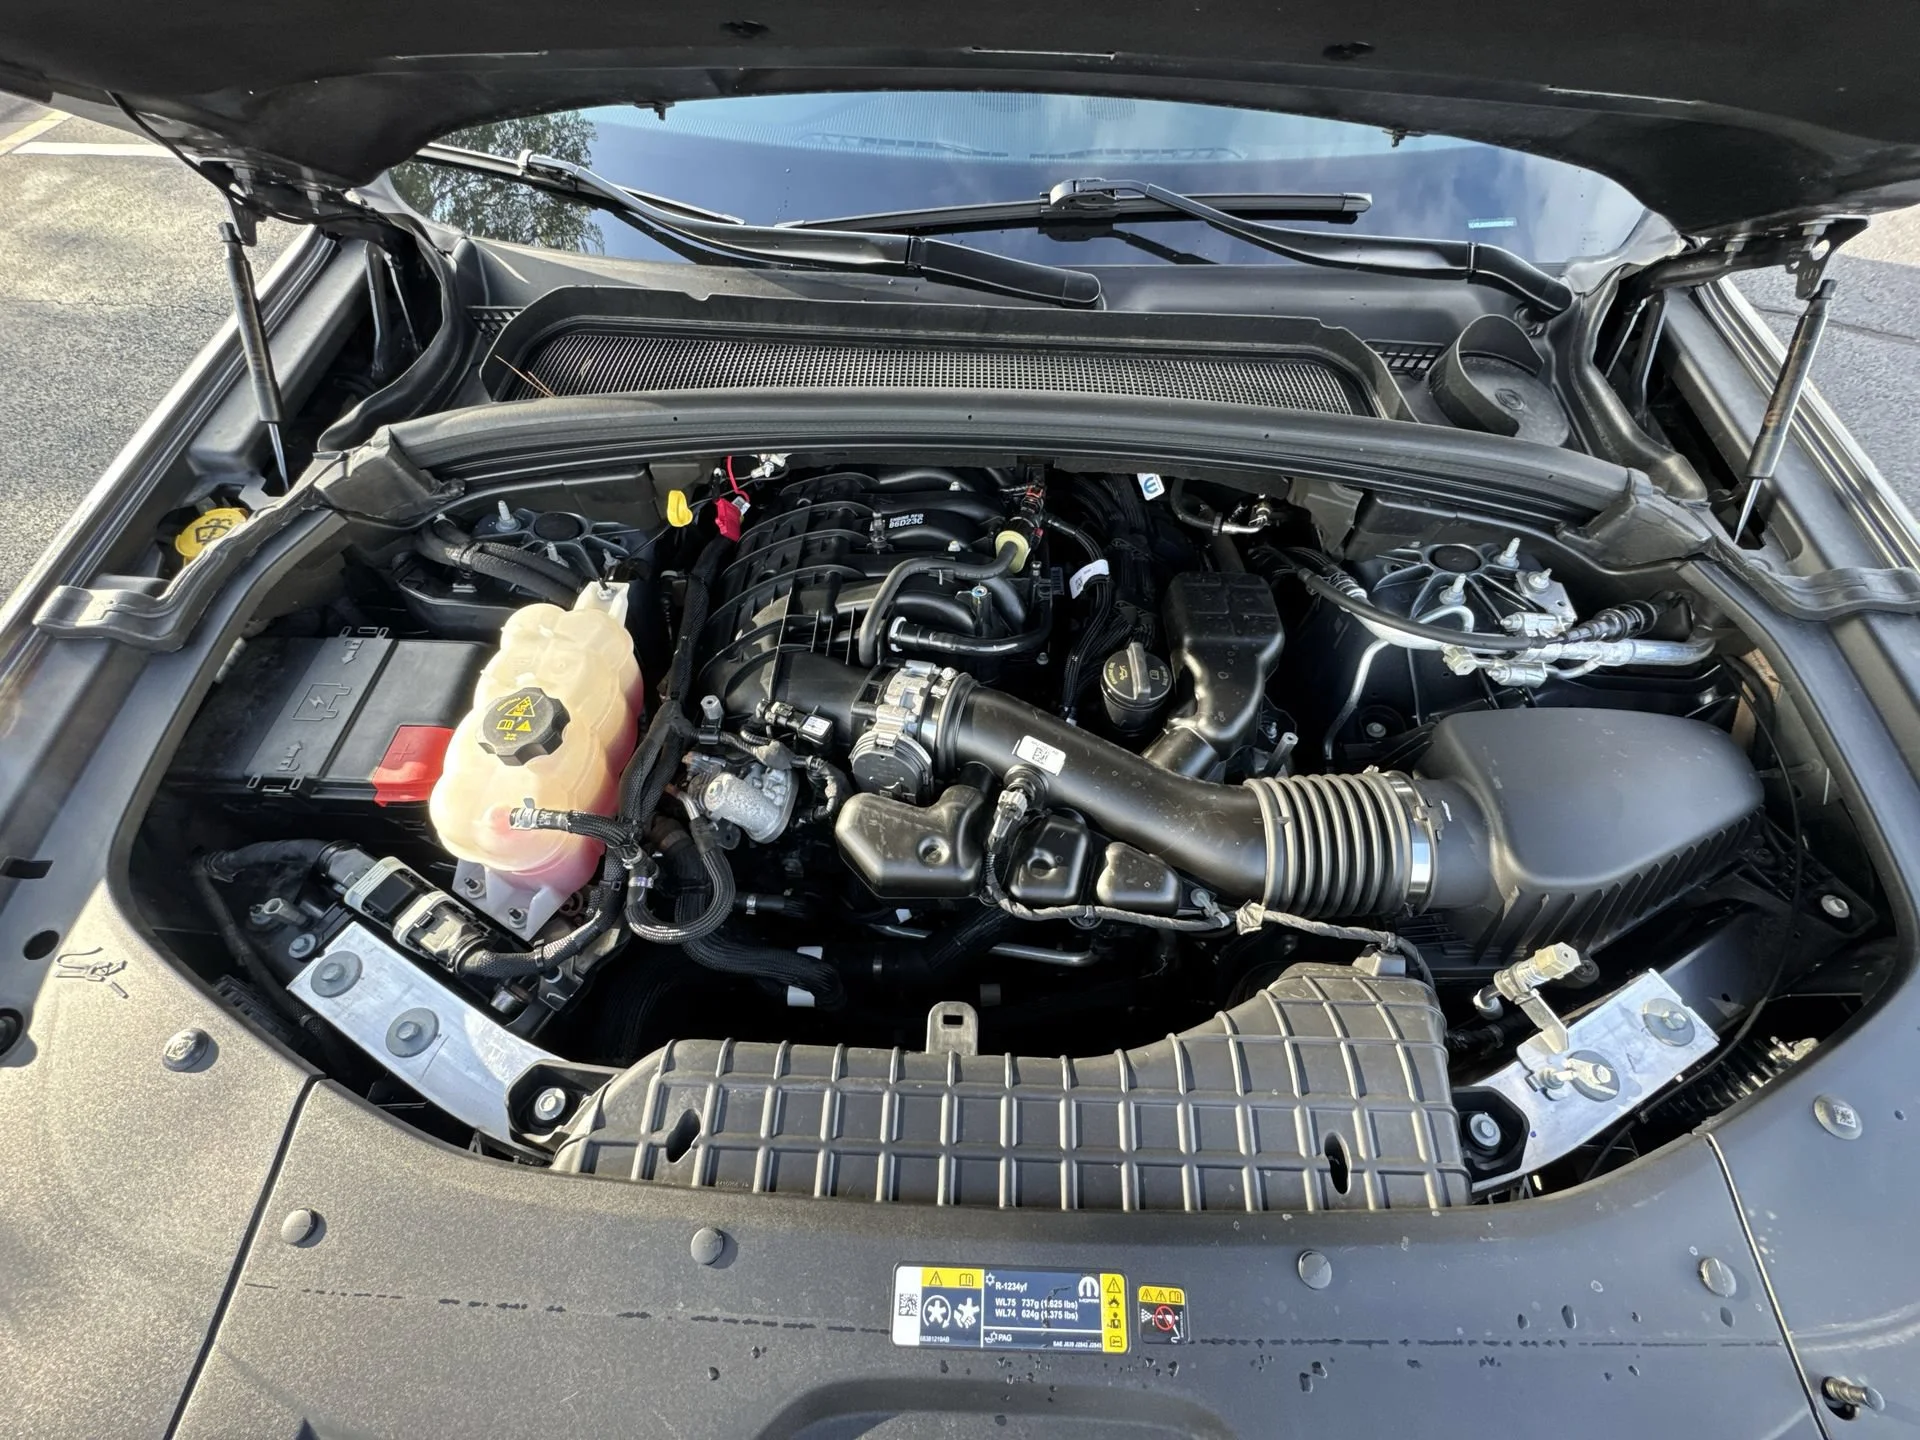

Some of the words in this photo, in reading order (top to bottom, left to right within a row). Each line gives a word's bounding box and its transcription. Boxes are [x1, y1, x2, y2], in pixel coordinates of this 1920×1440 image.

[995, 1281, 1028, 1293] R-1234yf
[995, 1297, 1016, 1307] WL75
[1021, 1298, 1039, 1309] 737g
[1040, 1298, 1062, 1309] (1.625
[1064, 1299, 1078, 1310] lbs)
[995, 1308, 1016, 1318] WL74
[1021, 1309, 1039, 1320] 624g
[1040, 1310, 1062, 1320] (1.375
[1064, 1310, 1078, 1321] lbs)
[998, 1333, 1012, 1342] PAG
